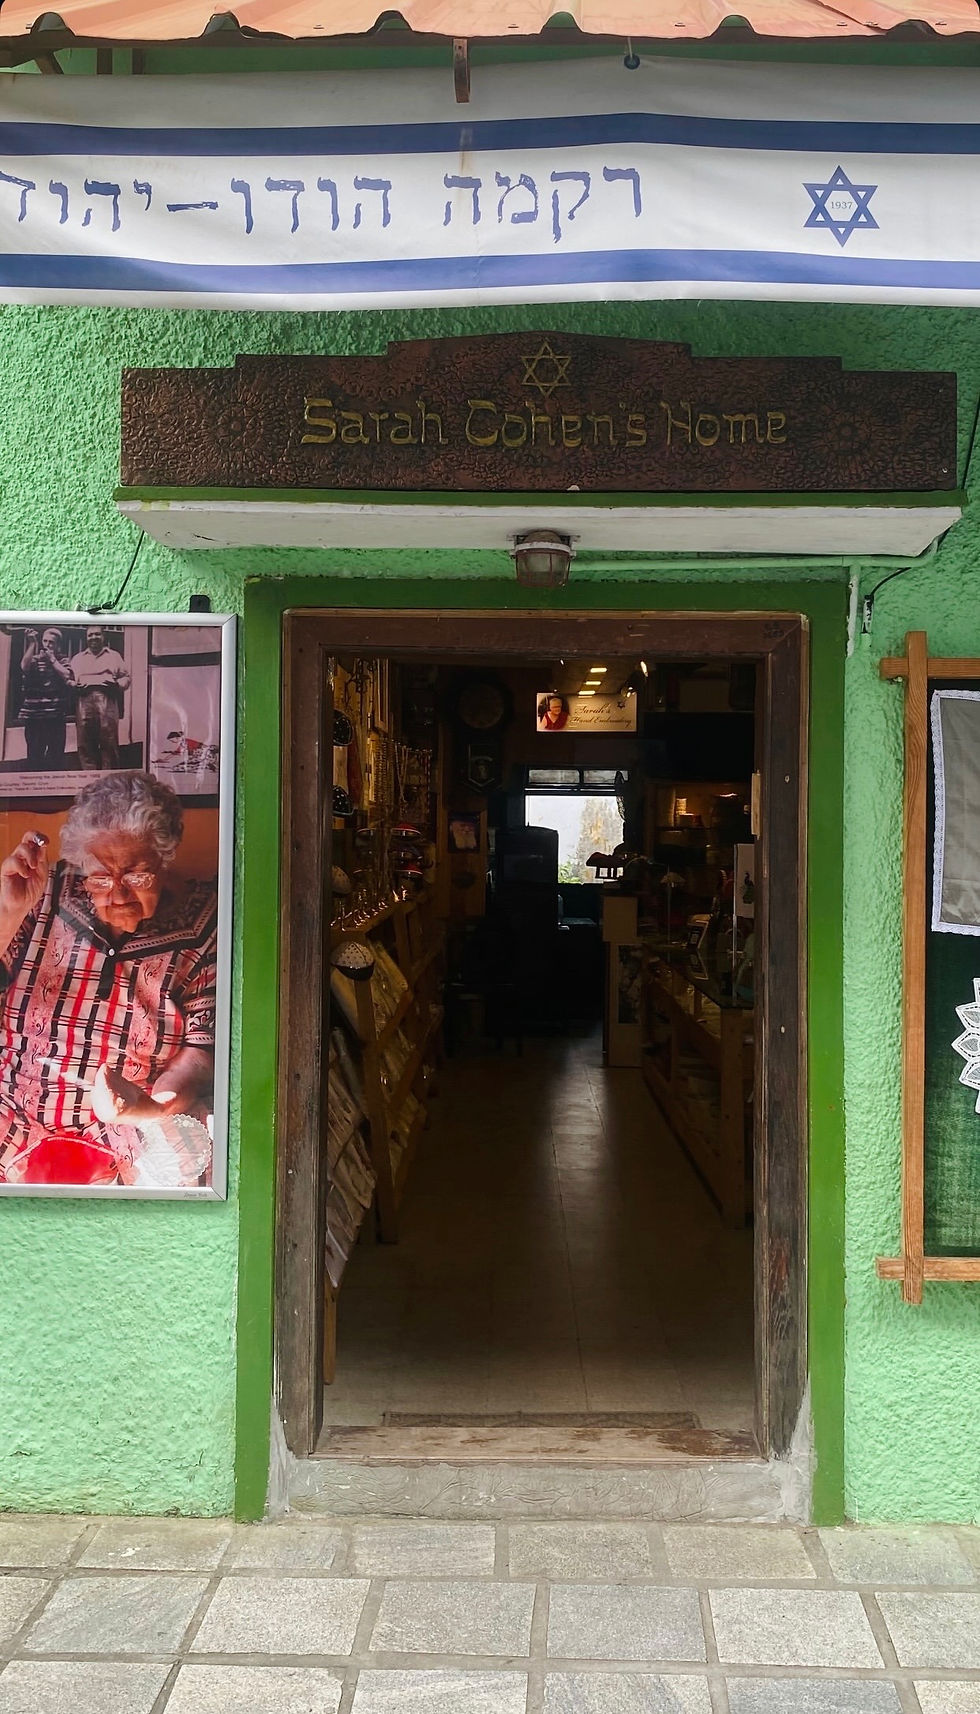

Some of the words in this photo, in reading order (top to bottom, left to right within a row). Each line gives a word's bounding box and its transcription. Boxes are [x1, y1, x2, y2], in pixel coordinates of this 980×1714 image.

[444, 165, 642, 244] רקמה
[830, 201, 853, 210] 1937
[300, 396, 449, 446] Sarah
[465, 399, 648, 448] Cohen's
[659, 399, 788, 446] Home
